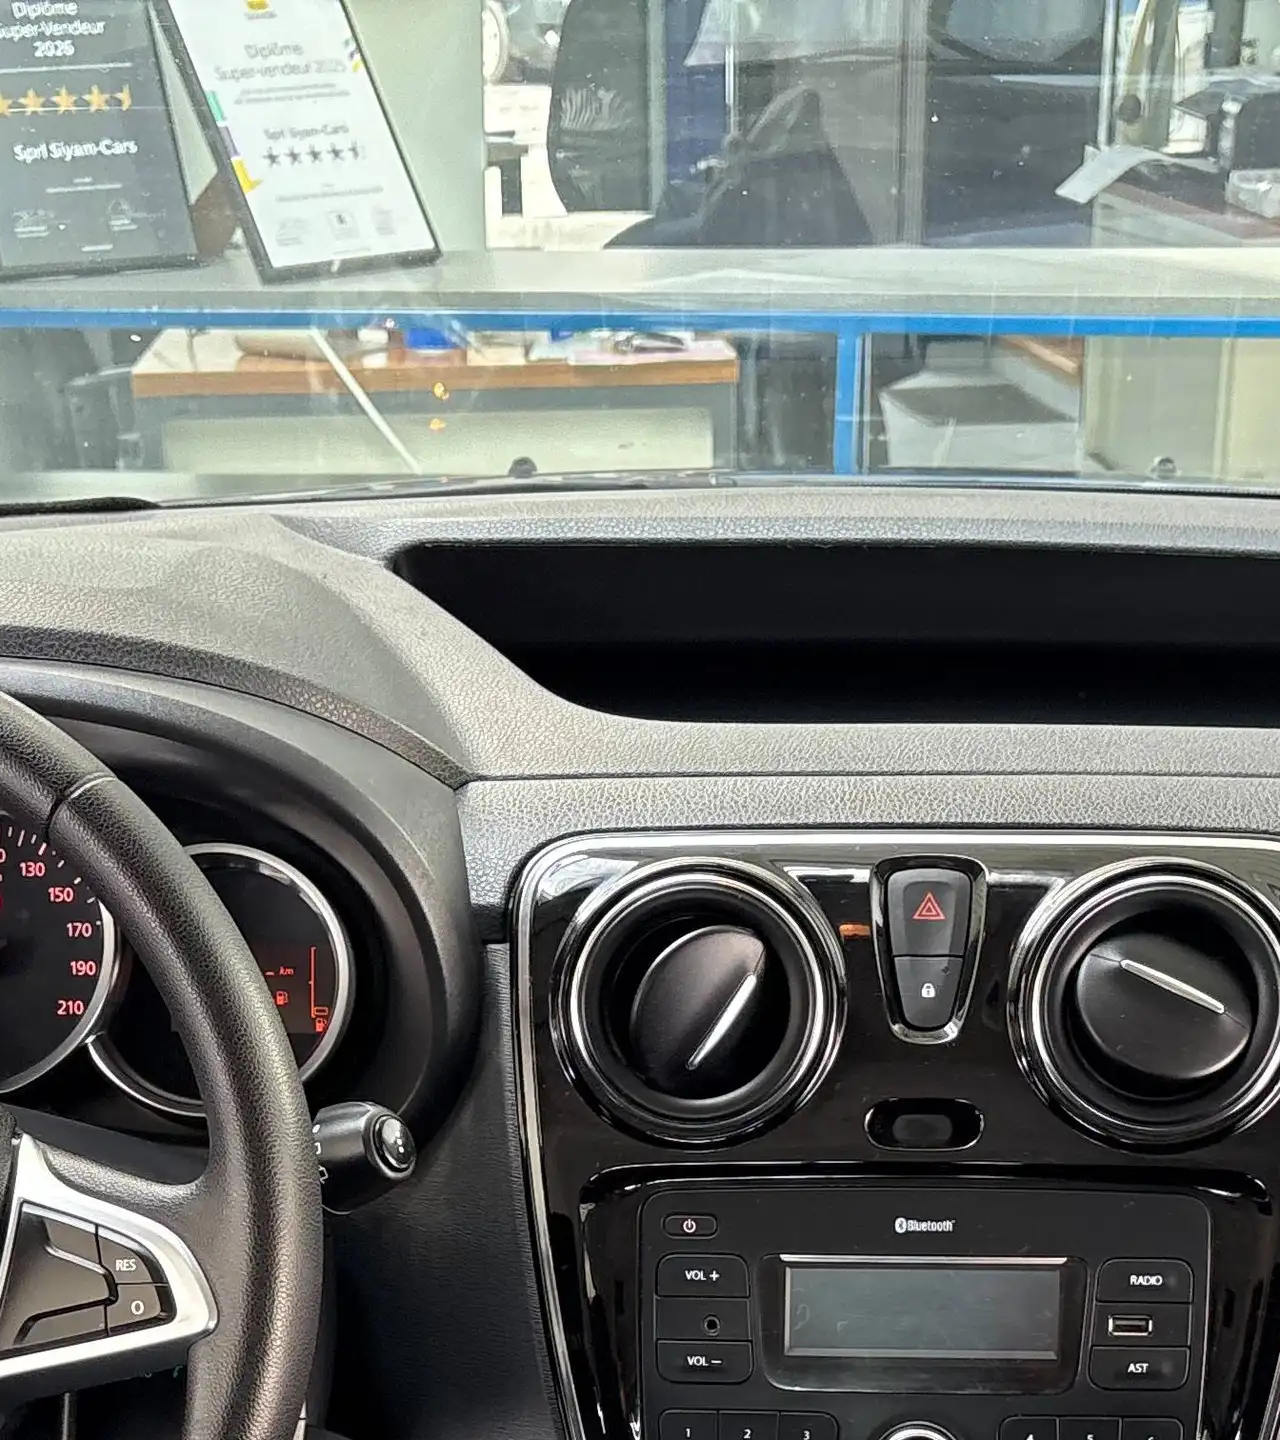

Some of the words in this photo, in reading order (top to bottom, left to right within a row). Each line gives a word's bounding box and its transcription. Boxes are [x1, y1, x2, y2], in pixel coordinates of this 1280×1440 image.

[19, 861, 45, 878] 130
[48, 887, 74, 903] 150
[66, 922, 93, 938] 170
[70, 961, 96, 977] 190
[56, 1000, 84, 1016] 210
[907, 1219, 954, 1232] Bluetooth
[115, 1258, 137, 1271] RES
[685, 1270, 707, 1281] VOL
[1130, 1275, 1163, 1286] RADIO
[687, 1356, 709, 1367] VOL
[1127, 1363, 1149, 1373] AST
[685, 1428, 691, 1438] 1
[743, 1428, 751, 1439] 2
[803, 1430, 811, 1440] 3
